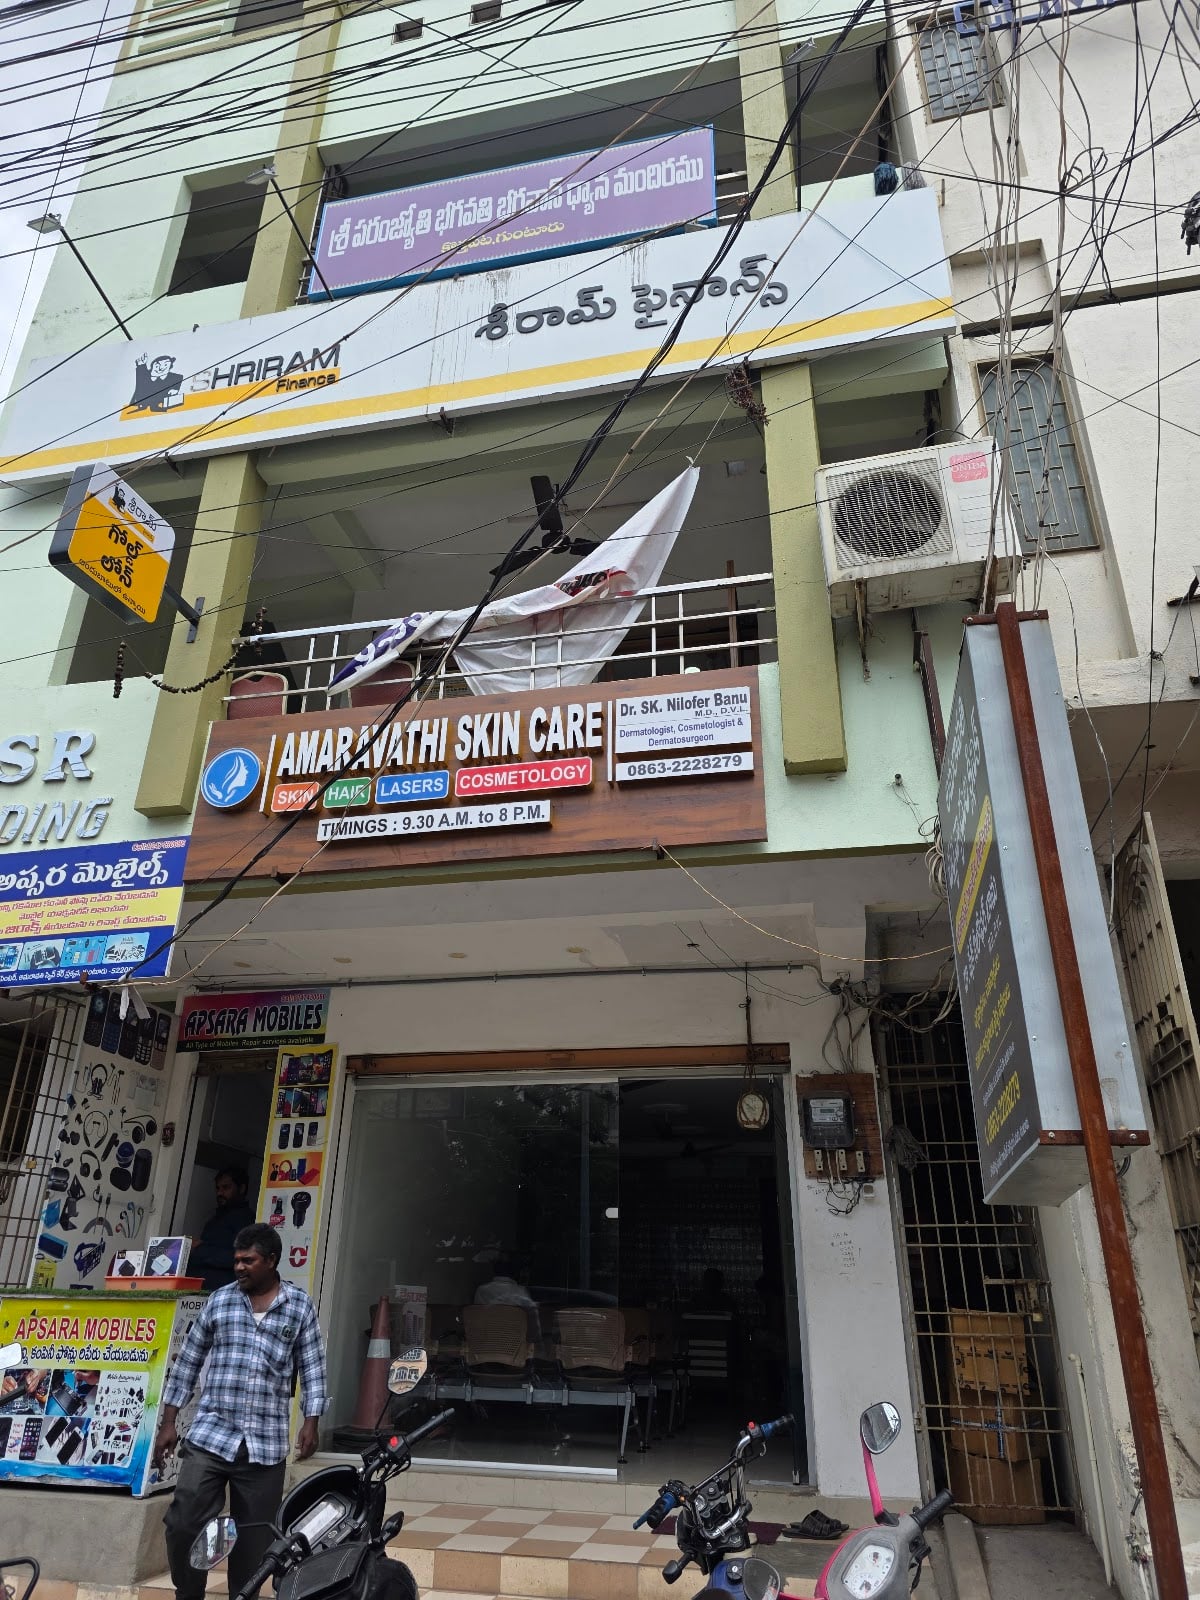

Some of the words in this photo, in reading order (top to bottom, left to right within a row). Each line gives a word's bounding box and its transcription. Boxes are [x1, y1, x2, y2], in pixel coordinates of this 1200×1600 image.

[328, 218, 351, 257] శ్రీ
[352, 203, 432, 249] పరంజ్యోతి
[435, 197, 493, 235] భగవతి
[614, 155, 703, 197] మందిరము
[475, 285, 617, 341] శ్రీరామ్
[631, 253, 788, 330] ఫైనాన్స్
[190, 343, 340, 392] SHRIRAM
[101, 554, 135, 588] లోన్
[620, 703, 637, 717] Dr.
[641, 701, 663, 715] SK.
[667, 696, 711, 712] Nilofer
[714, 692, 748, 707] Banu
[277, 717, 449, 777] AMARAVATHI
[455, 710, 521, 761] SKIN
[528, 702, 602, 753] CARE
[619, 725, 676, 739] Dermatologist,
[677, 719, 735, 732] Cosmetologist
[737, 717, 744, 726] &
[648, 733, 714, 748] Dermatosurgeon
[627, 754, 742, 777] 0863-2228279
[277, 787, 316, 806] SKIN
[327, 783, 367, 802] HAIR
[380, 778, 444, 797] LASERS
[459, 764, 587, 790] COSMETOLOGY
[321, 818, 388, 837] TIMINGS
[402, 815, 434, 831] 9.30
[438, 810, 473, 828] A.M.
[478, 810, 494, 824] to
[499, 808, 508, 822] 8
[513, 804, 545, 821] P.M.
[0, 863, 68, 897] అప్సర
[72, 850, 169, 888] మొబైల్స్
[184, 1007, 250, 1038] APSARA
[252, 1003, 323, 1033] MOBILES
[14, 1317, 79, 1341] APSARA
[84, 1317, 156, 1342] MOBILES
[78, 1343, 101, 1361] రిపేరు
[102, 1343, 149, 1362] చేయబడును
